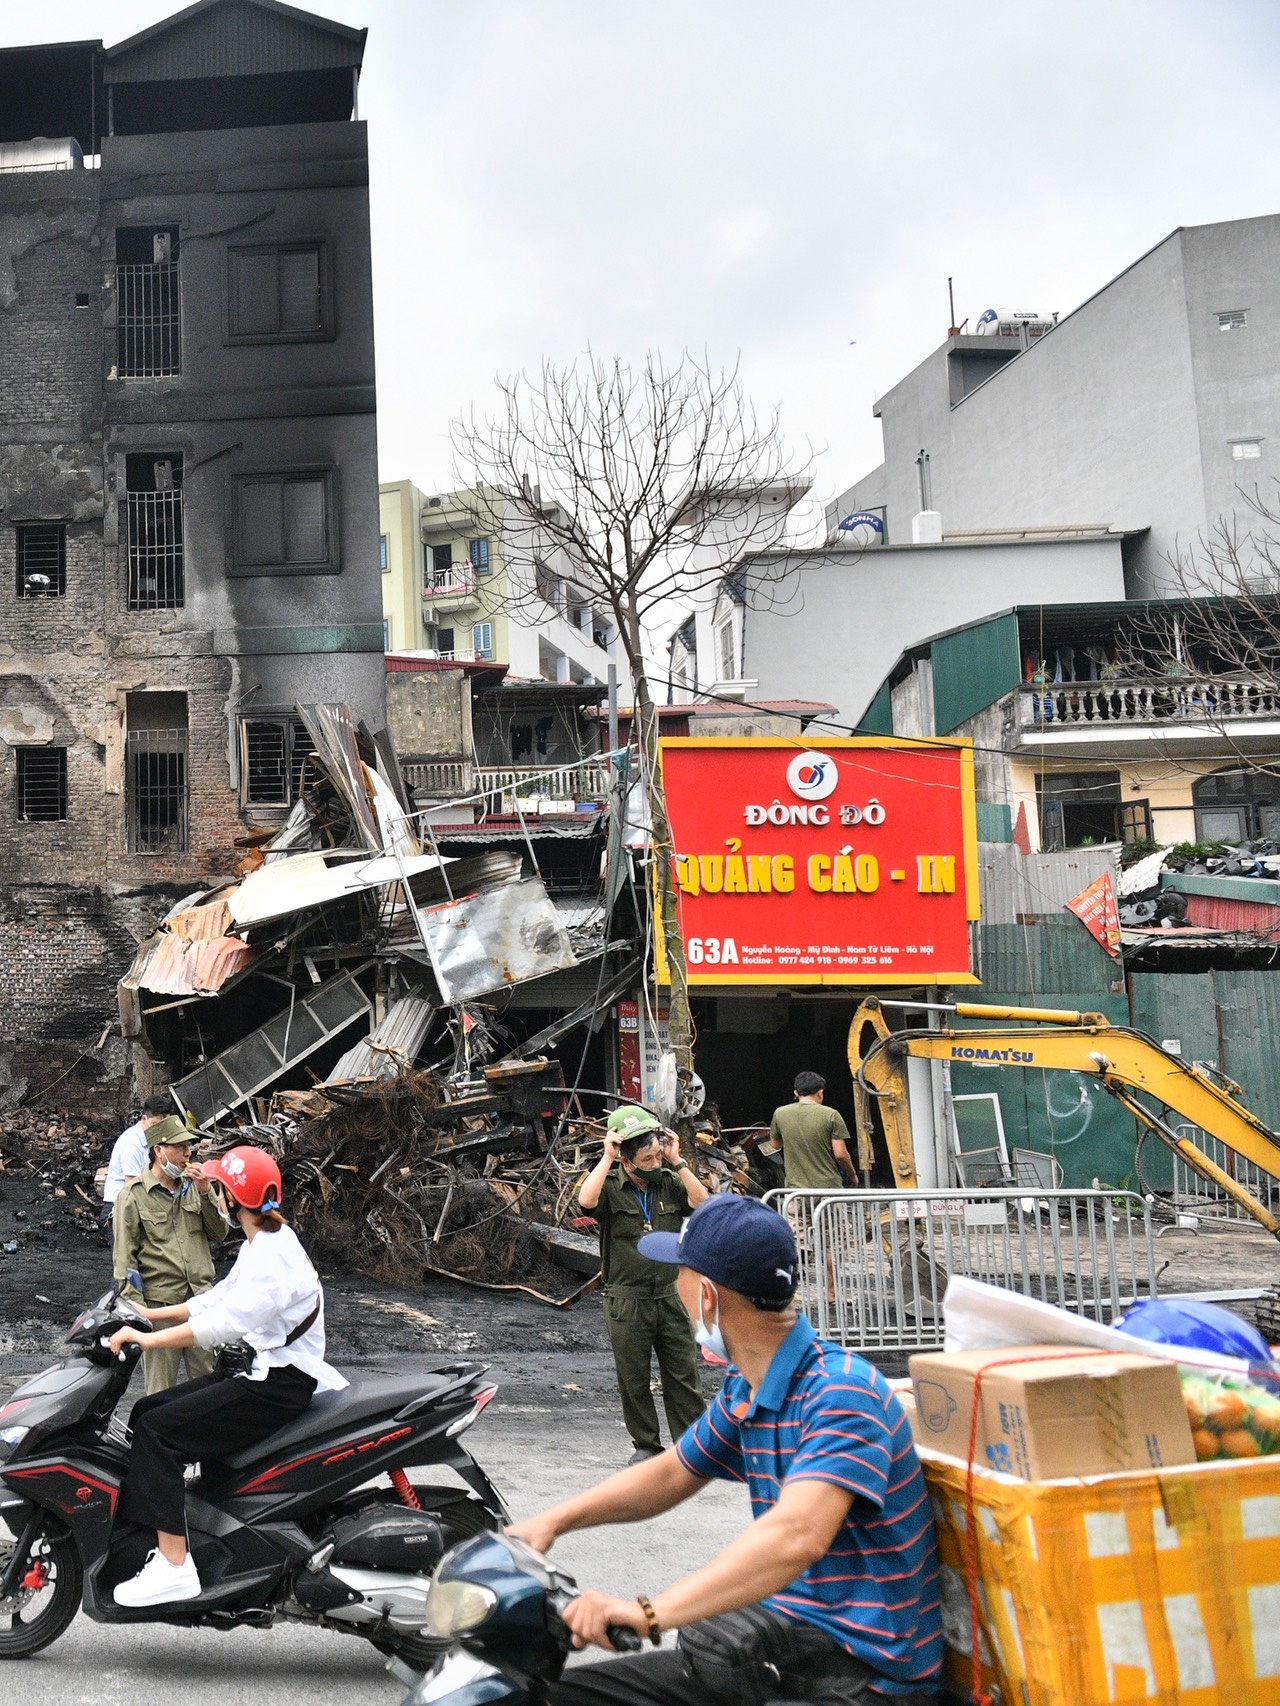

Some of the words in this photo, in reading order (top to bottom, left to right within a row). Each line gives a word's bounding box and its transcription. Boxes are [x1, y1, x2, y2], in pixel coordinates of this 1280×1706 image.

[743, 799, 830, 826] ĐÔNG
[838, 798, 886, 826] ĐÔ
[677, 837, 795, 897] QUẢNG
[807, 844, 880, 893] CÁO
[916, 855, 956, 893] IN
[687, 936, 740, 965] 63A
[741, 944, 773, 956] Nguyễn
[774, 945, 801, 955] Hoàng
[807, 945, 821, 955] Mỹ
[821, 945, 841, 954] Đình
[846, 945, 867, 954] Nam
[867, 944, 879, 954] Từ
[879, 945, 900, 954] Liêm
[906, 945, 918, 954] Hà
[920, 945, 934, 956] Nội
[742, 956, 774, 965] Hotline:
[778, 956, 798, 965] 0977
[799, 956, 815, 965] 424
[816, 956, 832, 965] 918
[837, 956, 859, 965] 0969
[861, 956, 877, 965] 325
[879, 956, 893, 965] 616
[620, 1017, 638, 1028] 63B
[951, 1047, 1034, 1063] KOMATSU
